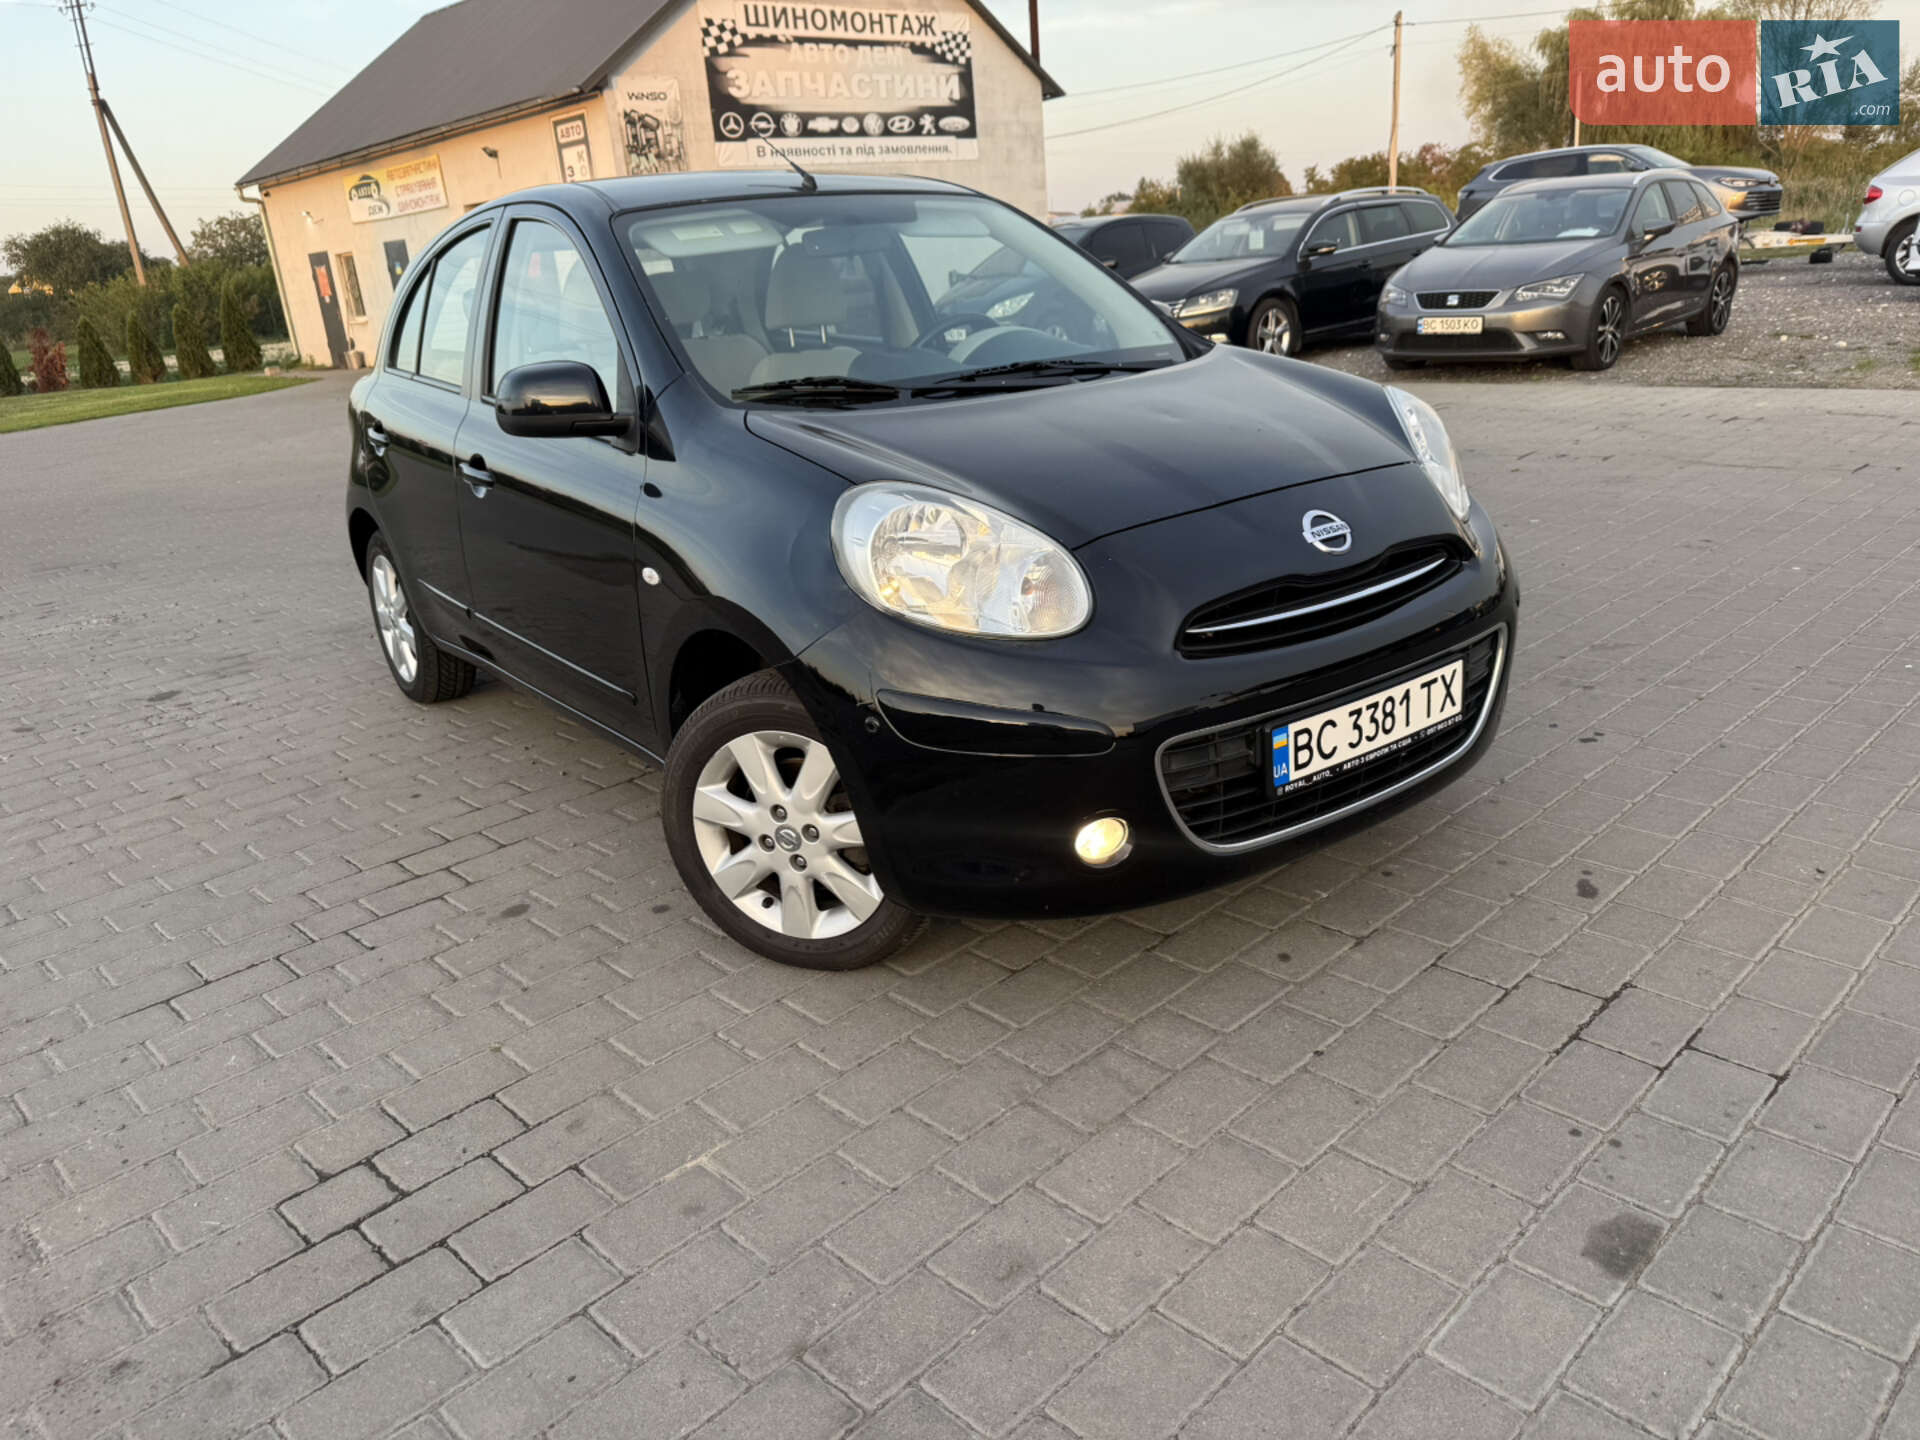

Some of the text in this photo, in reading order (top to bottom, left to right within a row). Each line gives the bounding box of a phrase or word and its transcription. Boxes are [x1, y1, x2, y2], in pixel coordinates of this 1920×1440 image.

[744, 5, 937, 36] ШИНОМОНТАЖ
[788, 42, 849, 65] АВТО
[727, 68, 961, 101] ЗАПЧАСТИНИ
[560, 124, 582, 139] АВТО
[757, 146, 766, 158] В
[840, 146, 852, 156] та
[856, 143, 874, 157] під
[1440, 319, 1462, 330] 1503
[1464, 319, 1479, 330] KO
[1311, 522, 1349, 539] NISSAN
[1293, 668, 1457, 772] BC 3381 TX
[1273, 764, 1289, 779] UA
